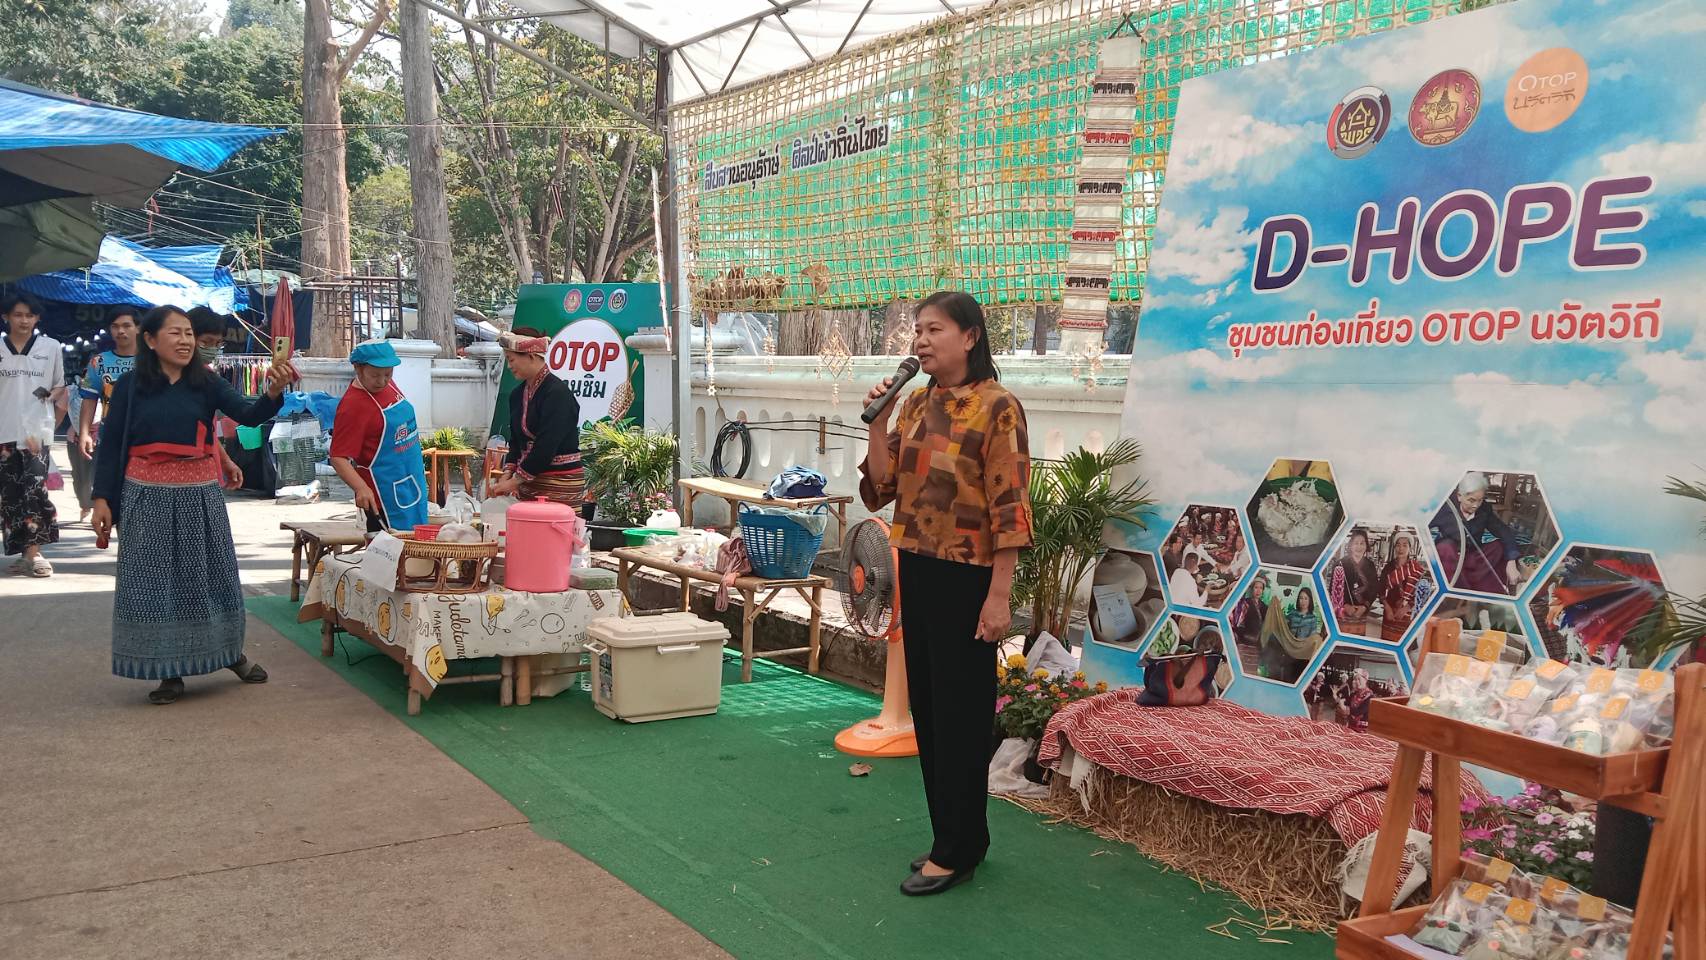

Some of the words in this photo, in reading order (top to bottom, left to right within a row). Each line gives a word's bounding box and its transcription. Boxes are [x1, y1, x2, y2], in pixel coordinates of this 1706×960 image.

[1518, 71, 1577, 92] OTOP
[1253, 175, 1653, 291] D-HOPE
[1229, 300, 1413, 357] ชุมชนท่องเที่ยว
[1422, 310, 1521, 342] OTOP
[1531, 298, 1662, 340] นวัตวิถี
[549, 340, 620, 372] OTOP
